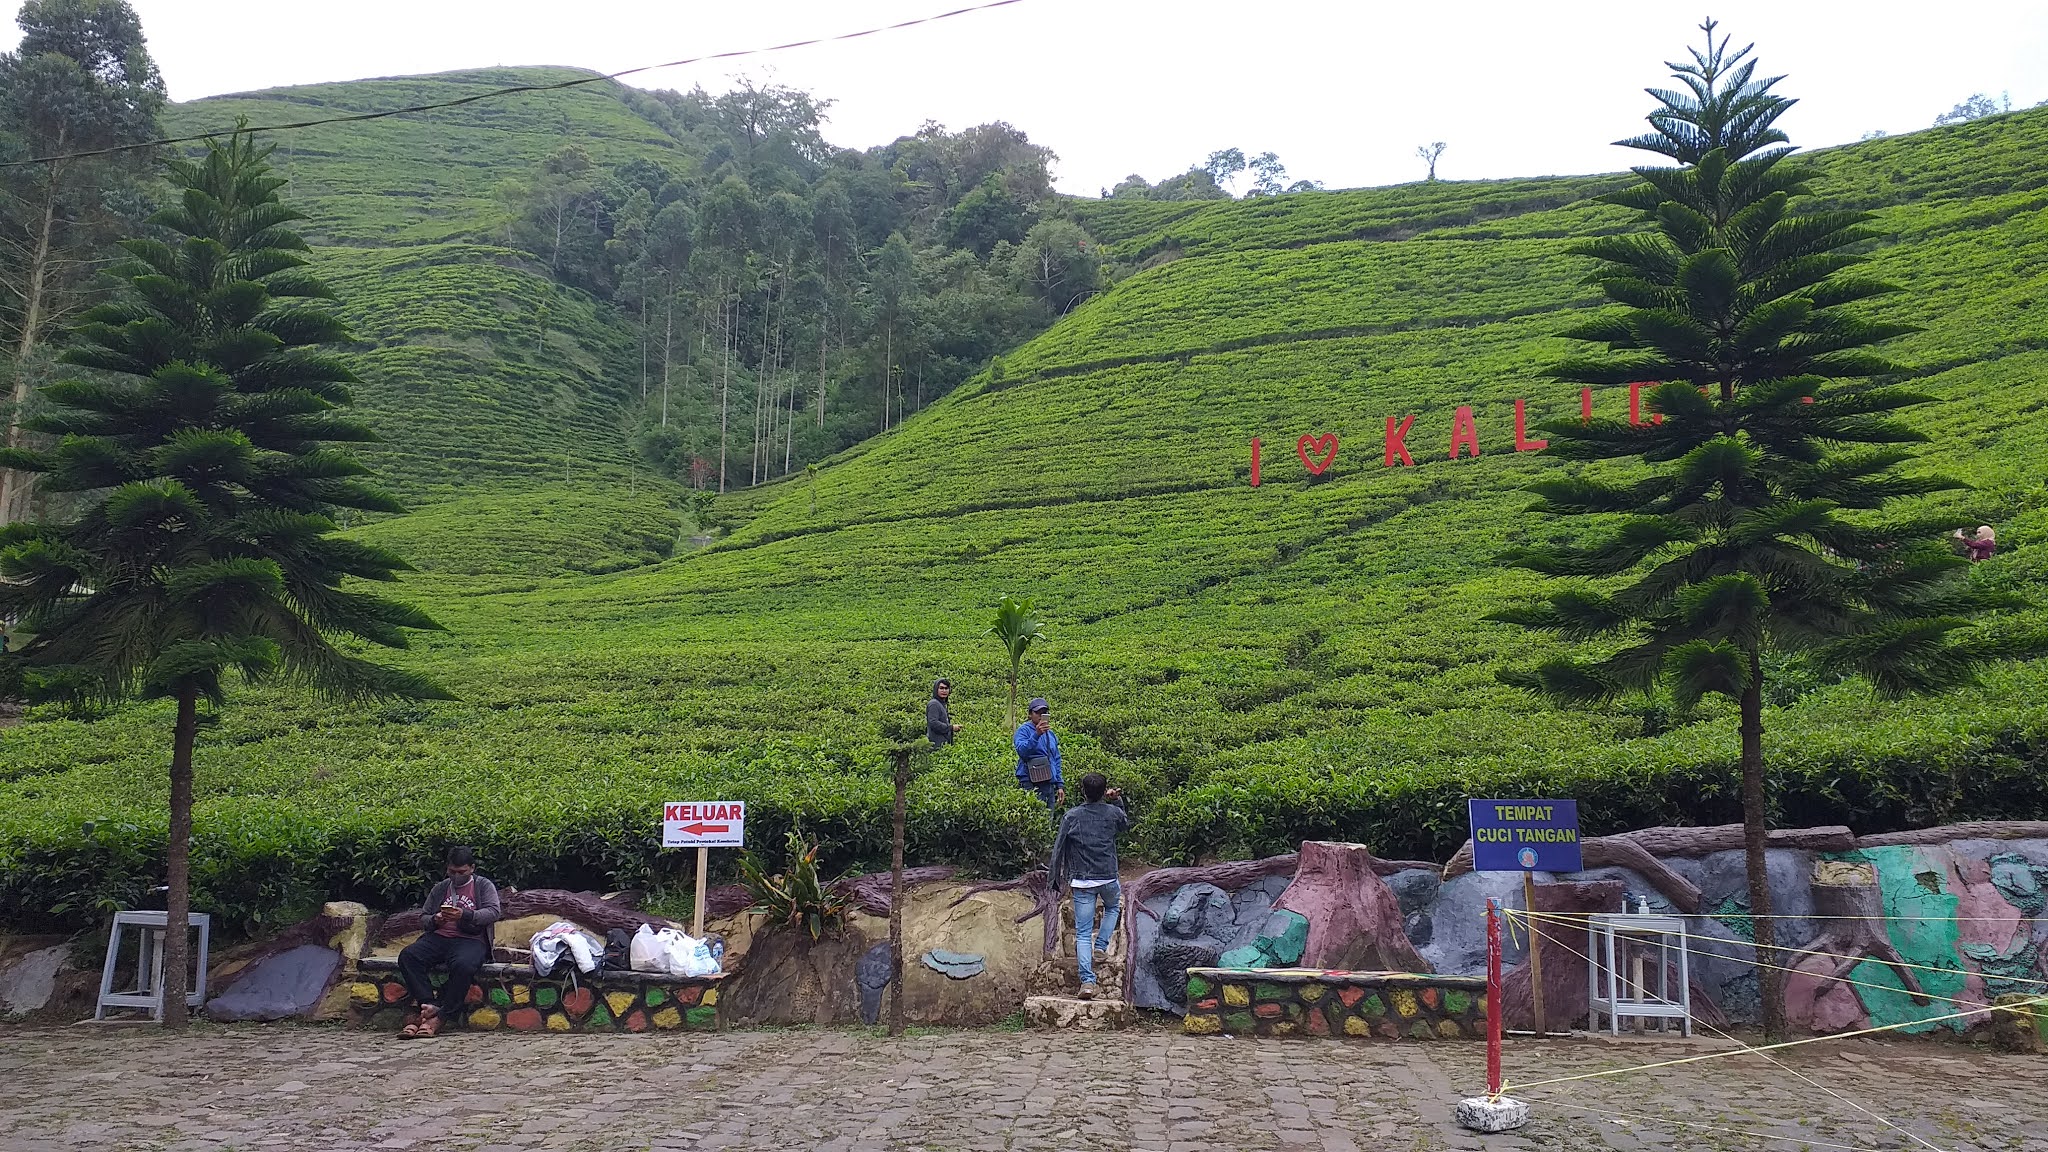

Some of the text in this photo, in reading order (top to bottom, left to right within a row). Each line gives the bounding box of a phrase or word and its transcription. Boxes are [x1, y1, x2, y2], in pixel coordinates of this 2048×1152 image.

[665, 805, 742, 821] KELUAR
[1494, 805, 1553, 821] TEMPAT
[1476, 827, 1577, 843] CUCI TANGAN
